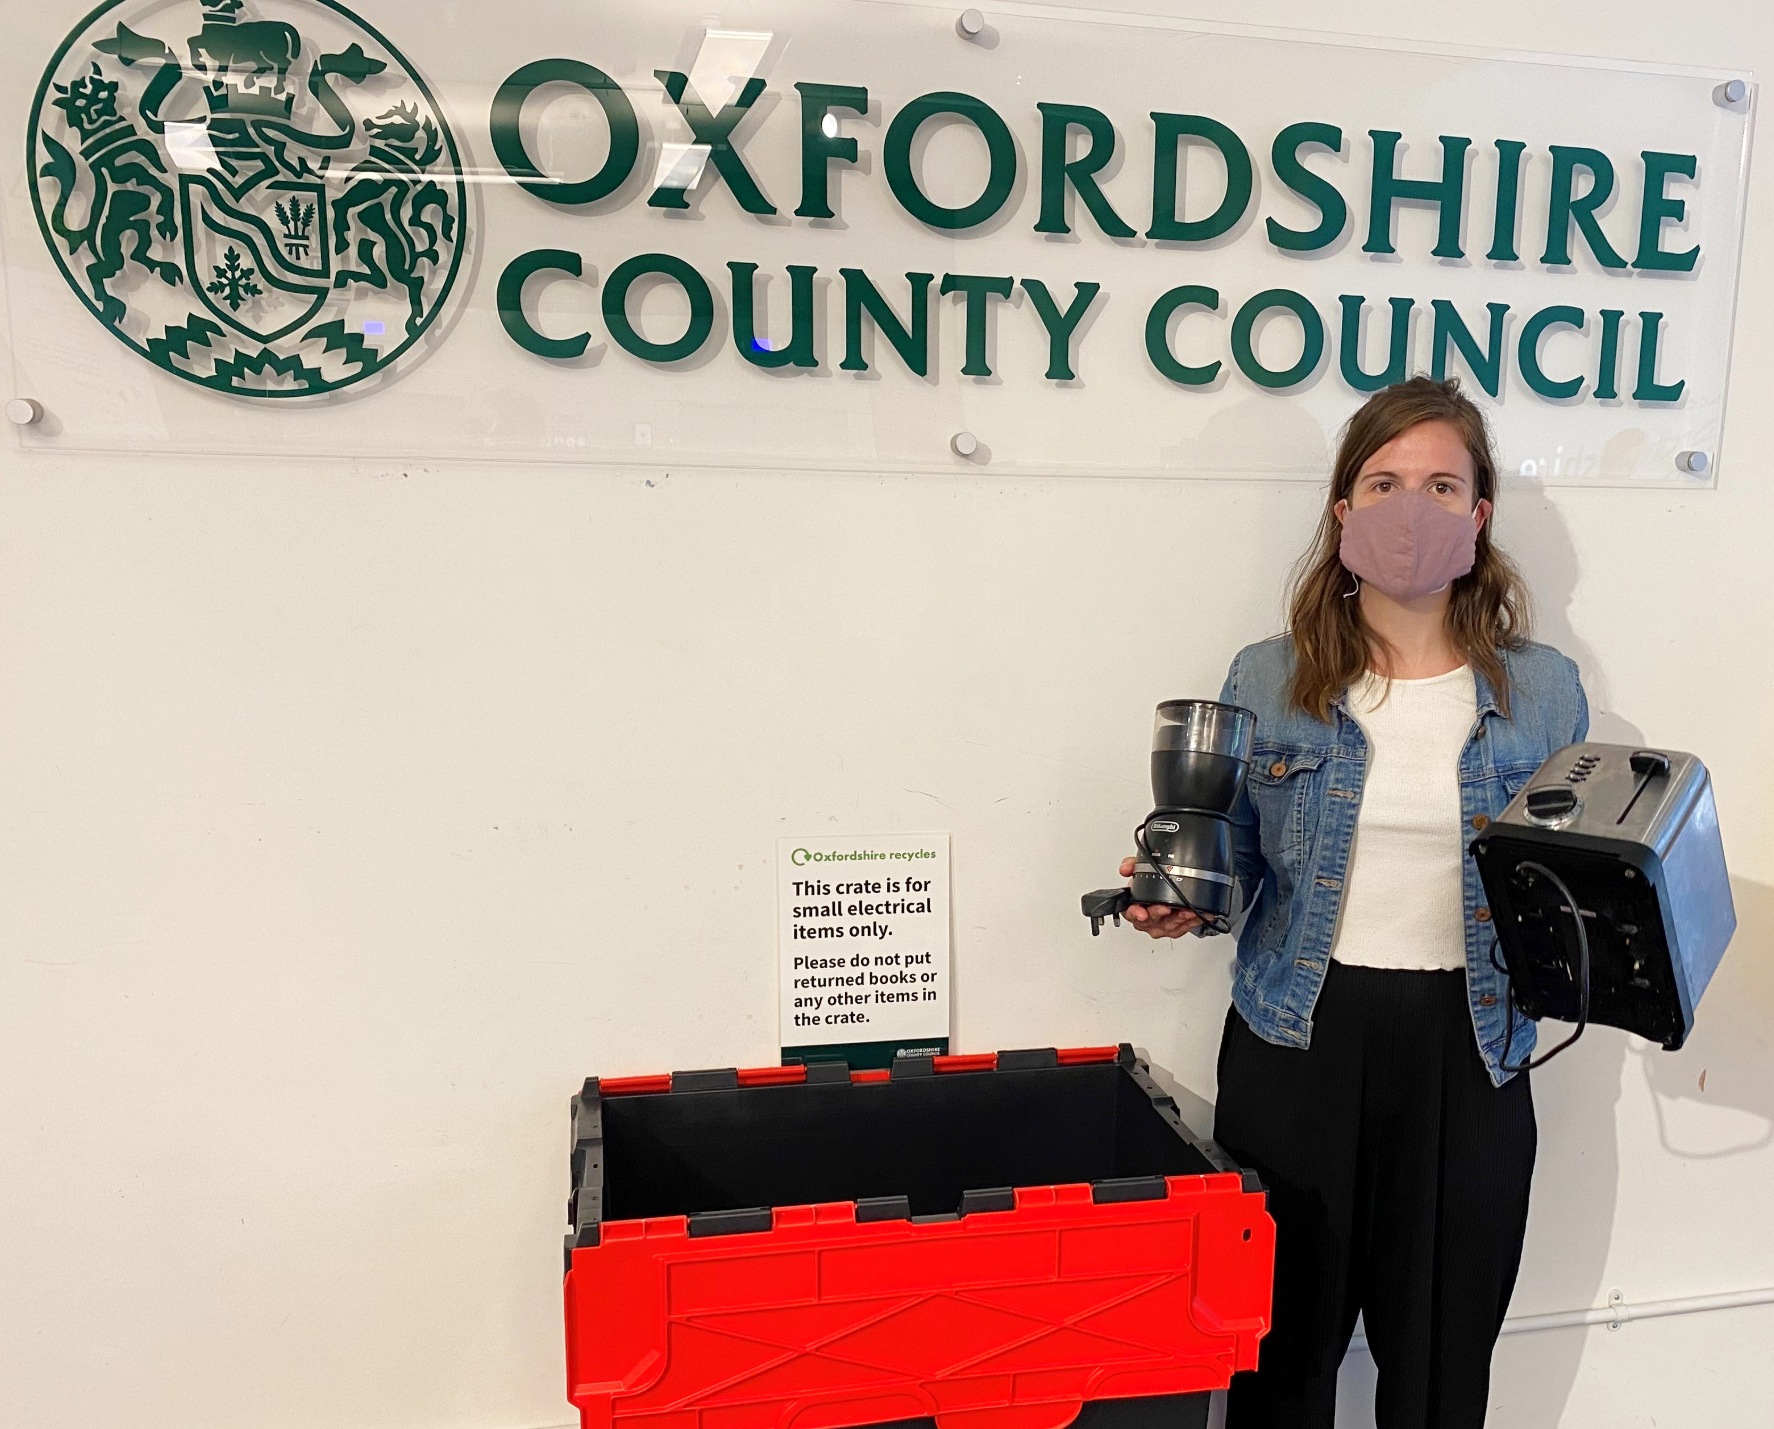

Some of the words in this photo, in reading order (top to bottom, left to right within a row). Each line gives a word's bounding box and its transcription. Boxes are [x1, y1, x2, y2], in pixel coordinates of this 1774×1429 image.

[489, 58, 1701, 273] OXFORDSHIRE
[496, 248, 1101, 382] COUNTY
[1145, 284, 1686, 402] COUNCIL
[813, 851, 886, 862] Oxfordshire
[889, 849, 936, 861] recycles
[792, 880, 830, 896] This
[836, 880, 881, 894] crate
[886, 878, 900, 892] is
[905, 877, 931, 892] for
[793, 901, 842, 918] small
[848, 898, 932, 916] electrical
[793, 924, 844, 939] items
[849, 922, 892, 940] only.
[794, 956, 846, 970] Please
[850, 954, 870, 967] do
[874, 953, 900, 966] not
[905, 952, 931, 968] put
[794, 972, 864, 988] returned
[870, 971, 916, 985] books
[920, 972, 937, 982] or
[794, 996, 823, 1010] any
[828, 992, 871, 1006] other
[875, 990, 918, 1003] items
[922, 988, 936, 1001] in
[794, 1013, 820, 1026] the
[825, 1012, 870, 1024] crate.
